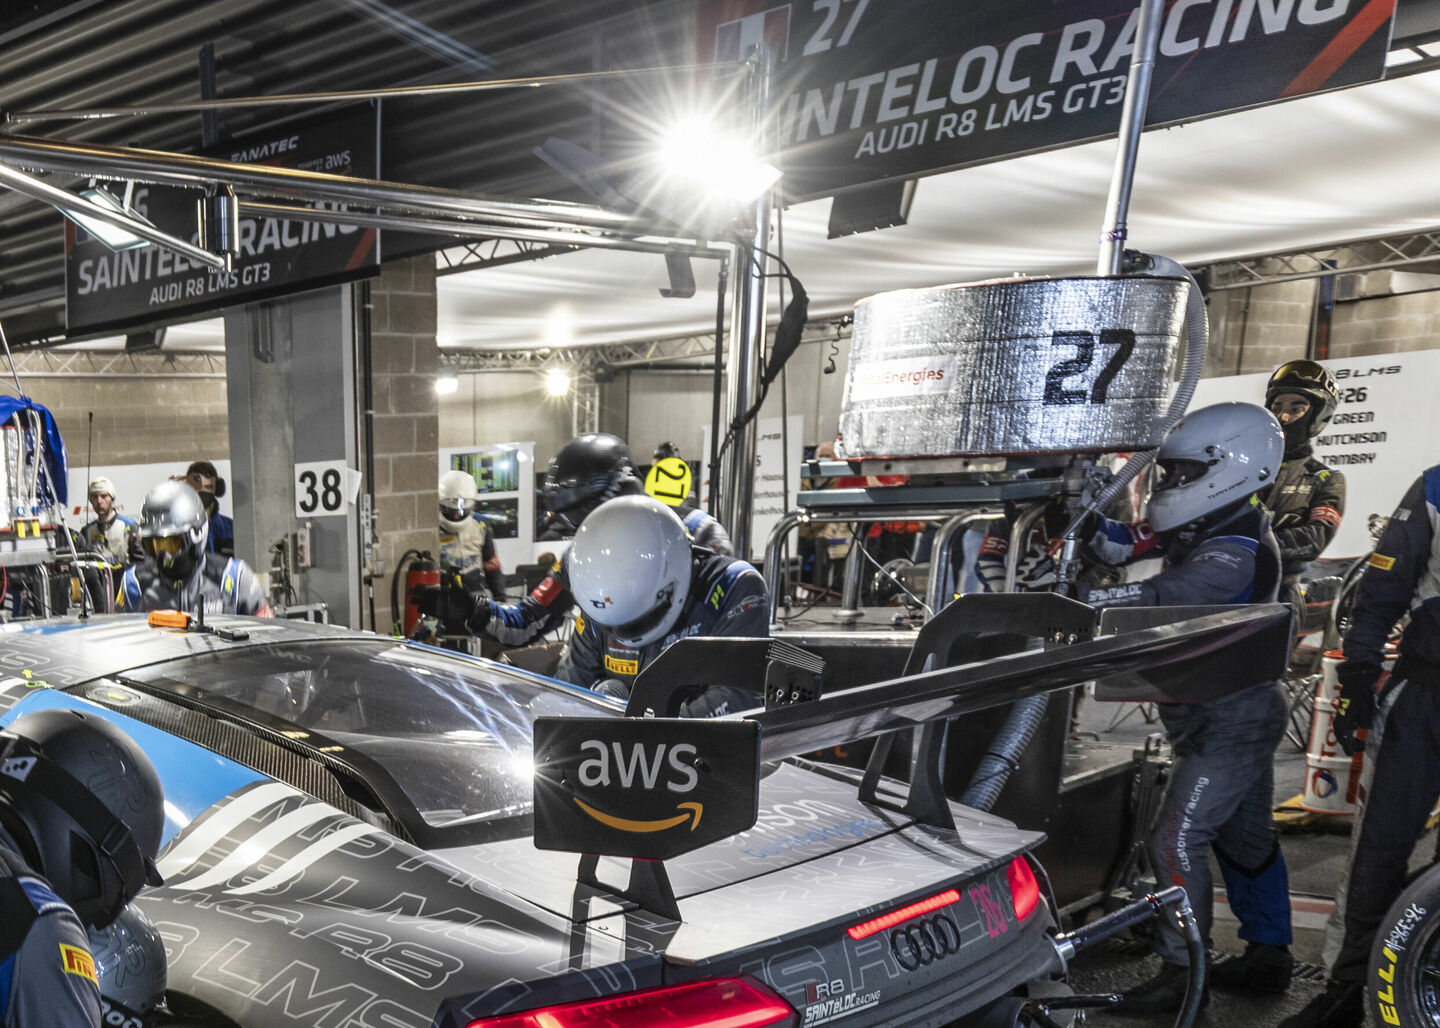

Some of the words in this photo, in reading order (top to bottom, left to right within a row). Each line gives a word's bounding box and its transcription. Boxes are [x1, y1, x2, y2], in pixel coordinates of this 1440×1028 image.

[803, 0, 867, 57] 27
[780, 32, 1046, 148] INTELOC
[855, 117, 929, 159] AUDI
[935, 107, 977, 139] R8
[985, 89, 1057, 131] LMS
[1063, 76, 1127, 117] GT3
[230, 136, 299, 163] FANATEC
[325, 150, 351, 170] aws
[149, 281, 182, 306] AUDI
[186, 277, 205, 299] R8
[208, 269, 238, 294] LMS
[242, 262, 271, 286] GT3
[1043, 328, 1136, 405] 27
[1353, 366, 1402, 378] LMS
[1333, 411, 1375, 425] GREEN
[1316, 431, 1388, 447] HUTCHISON
[1322, 452, 1376, 466] TAMBAY
[299, 469, 342, 512] 38
[653, 462, 687, 500] 27
[578, 739, 699, 793] aws
[1176, 816, 1192, 872] customer
[1185, 776, 1210, 815] racing
[971, 883, 1008, 938] 26
[817, 978, 845, 998] R8
[856, 989, 881, 1006] RACING
